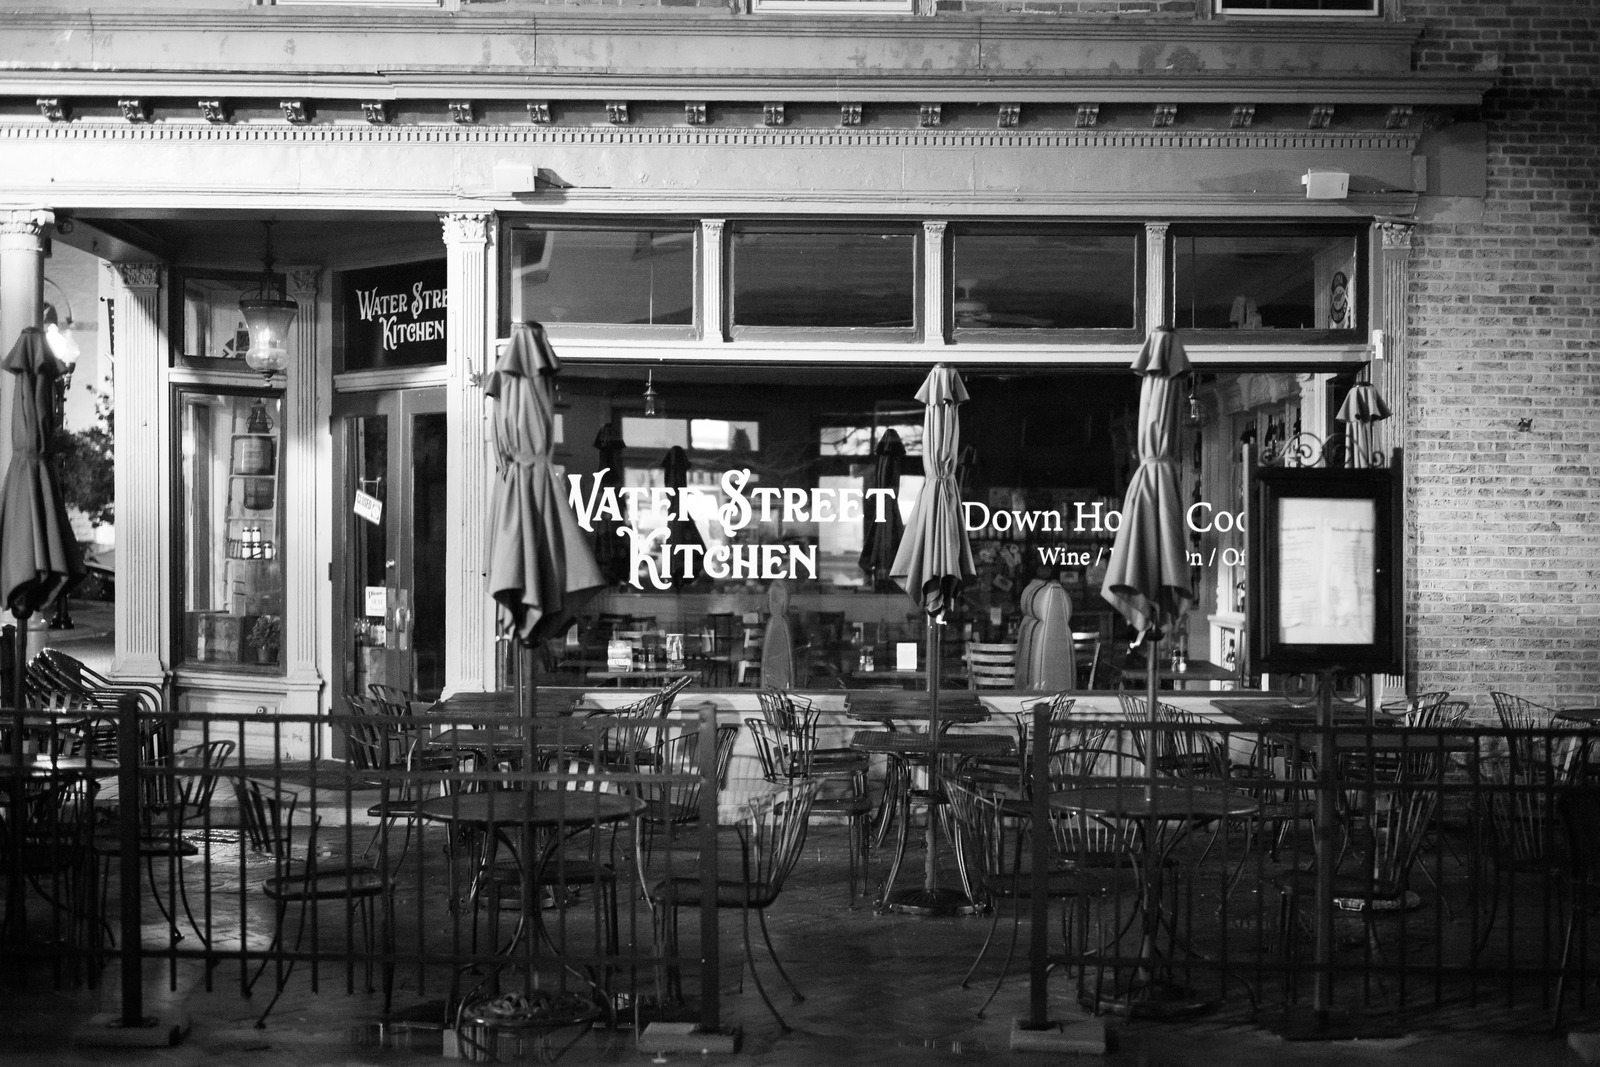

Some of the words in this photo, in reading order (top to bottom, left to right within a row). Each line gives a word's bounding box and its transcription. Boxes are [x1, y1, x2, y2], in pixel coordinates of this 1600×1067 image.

[355, 286, 408, 322] WATER
[378, 315, 445, 351] KITCHEN
[718, 468, 897, 538] STREET
[961, 501, 1063, 532] Down
[616, 526, 818, 590] KITCHEN
[1037, 546, 1091, 566] Wine
